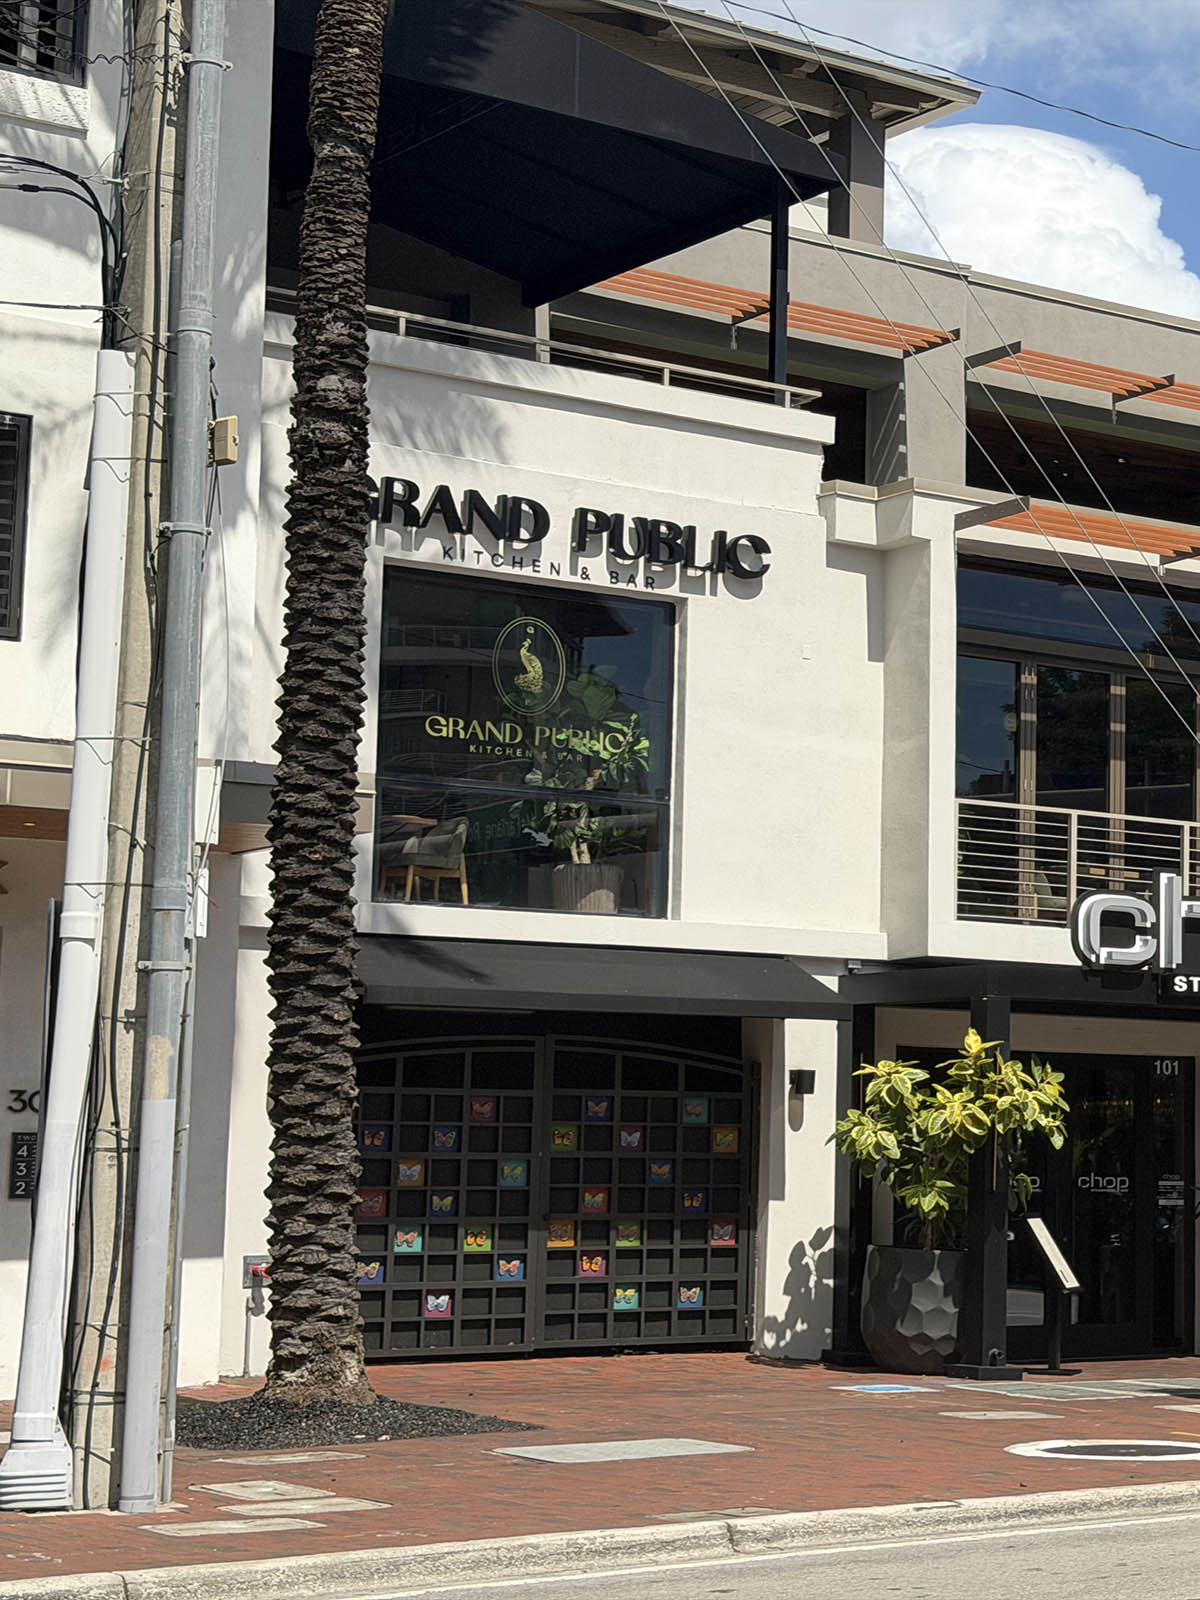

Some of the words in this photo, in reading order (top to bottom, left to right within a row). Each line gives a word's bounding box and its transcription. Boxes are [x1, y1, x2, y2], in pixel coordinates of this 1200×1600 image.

[572, 507, 771, 579] PUBLIC
[443, 545, 561, 577] KITCHEN
[580, 566, 591, 581] &
[609, 570, 656, 591] BAR
[425, 715, 524, 745] GRAND
[469, 744, 534, 759] KITCHEN
[1154, 1060, 1180, 1076] 101
[17, 1145, 29, 1158] 4
[16, 1162, 27, 1176] 3
[15, 1181, 26, 1195] 2
[1077, 1172, 1129, 1192] chop
